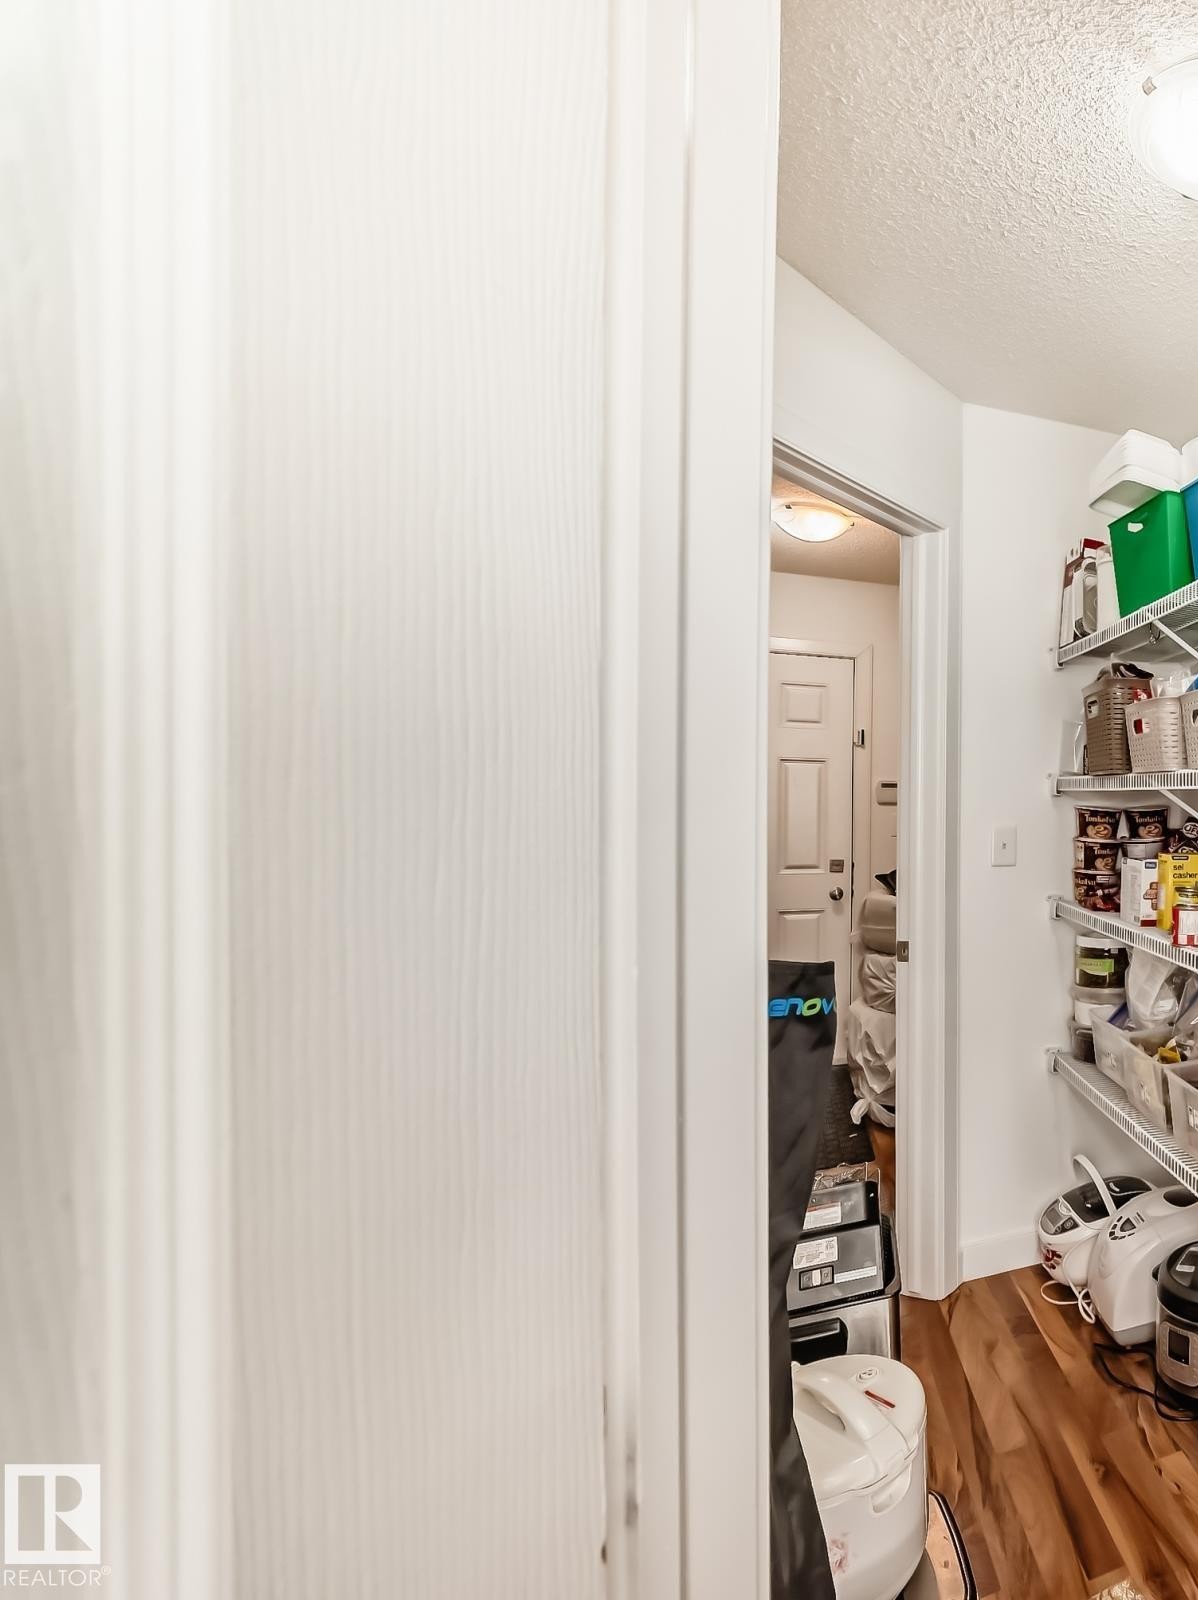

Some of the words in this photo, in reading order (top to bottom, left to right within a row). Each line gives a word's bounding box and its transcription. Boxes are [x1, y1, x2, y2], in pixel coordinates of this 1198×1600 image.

[1173, 863, 1184, 871] sel
[1173, 871, 1198, 879] casher
[769, 997, 837, 1017] enov
